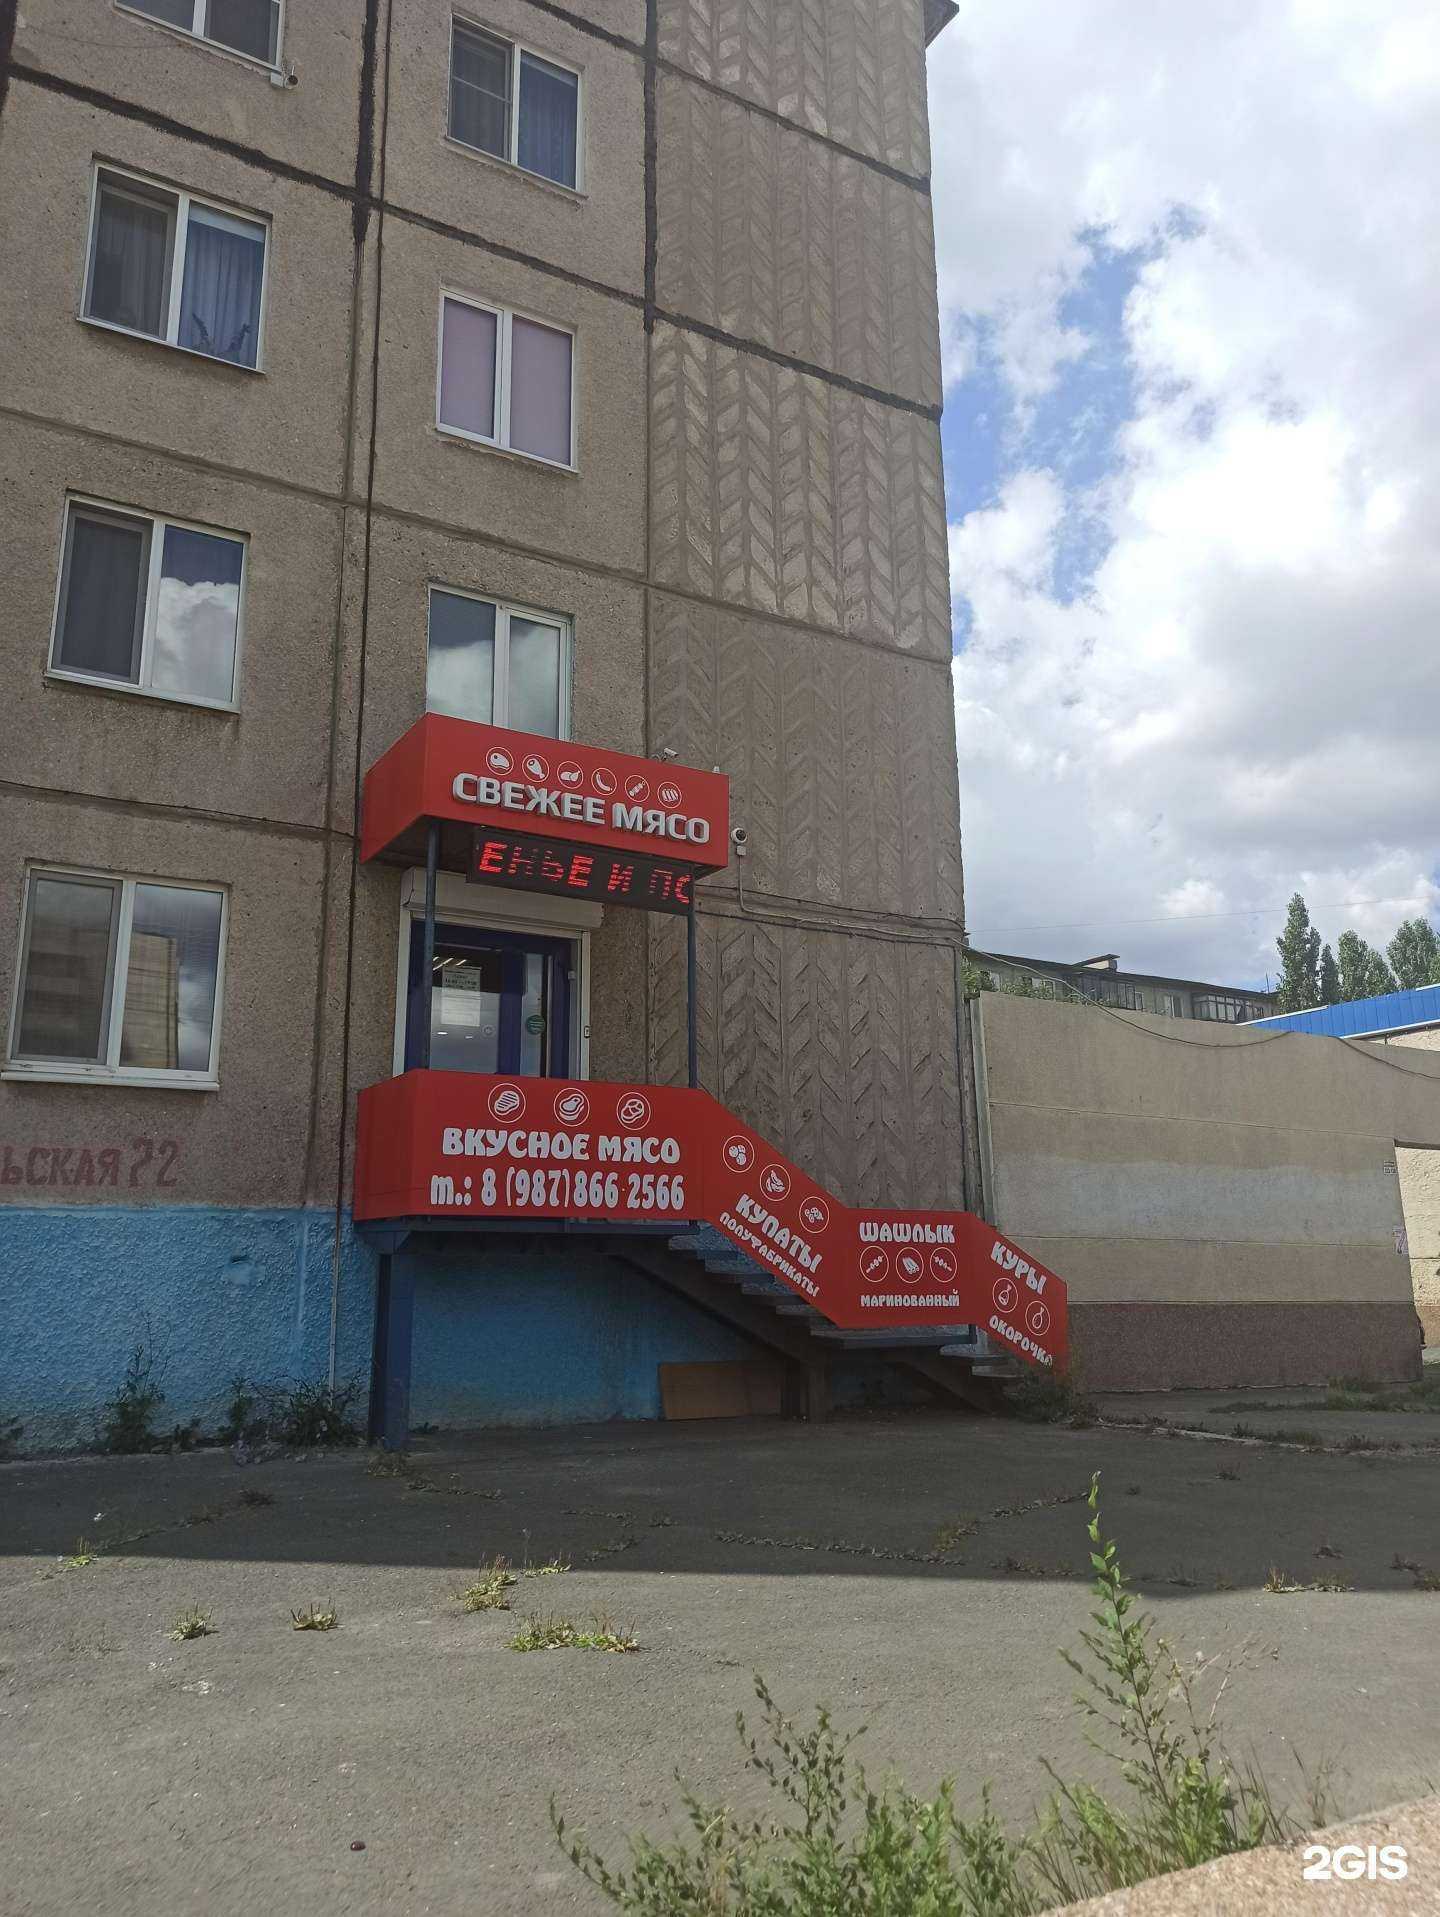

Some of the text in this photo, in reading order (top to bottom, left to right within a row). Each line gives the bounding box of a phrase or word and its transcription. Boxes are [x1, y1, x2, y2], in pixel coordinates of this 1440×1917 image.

[452, 772, 711, 844] СВЕЖЕЕ МЯСО
[479, 840, 594, 887] ЕНЬЕ
[608, 863, 634, 893] И
[442, 1127, 681, 1164] ВКУСНОЕ МЯСО
[482, 1167, 497, 1206] 8
[626, 1172, 685, 1210] 2566
[719, 1211, 820, 1297] ПОЛУФАБРИКАТЫ
[735, 1193, 823, 1274] КУПАТЫ
[859, 1222, 956, 1244] ШАШЛЫК
[990, 1241, 1048, 1295] КУРЫ
[860, 1288, 961, 1308] МАРИНОВАННЫЙ
